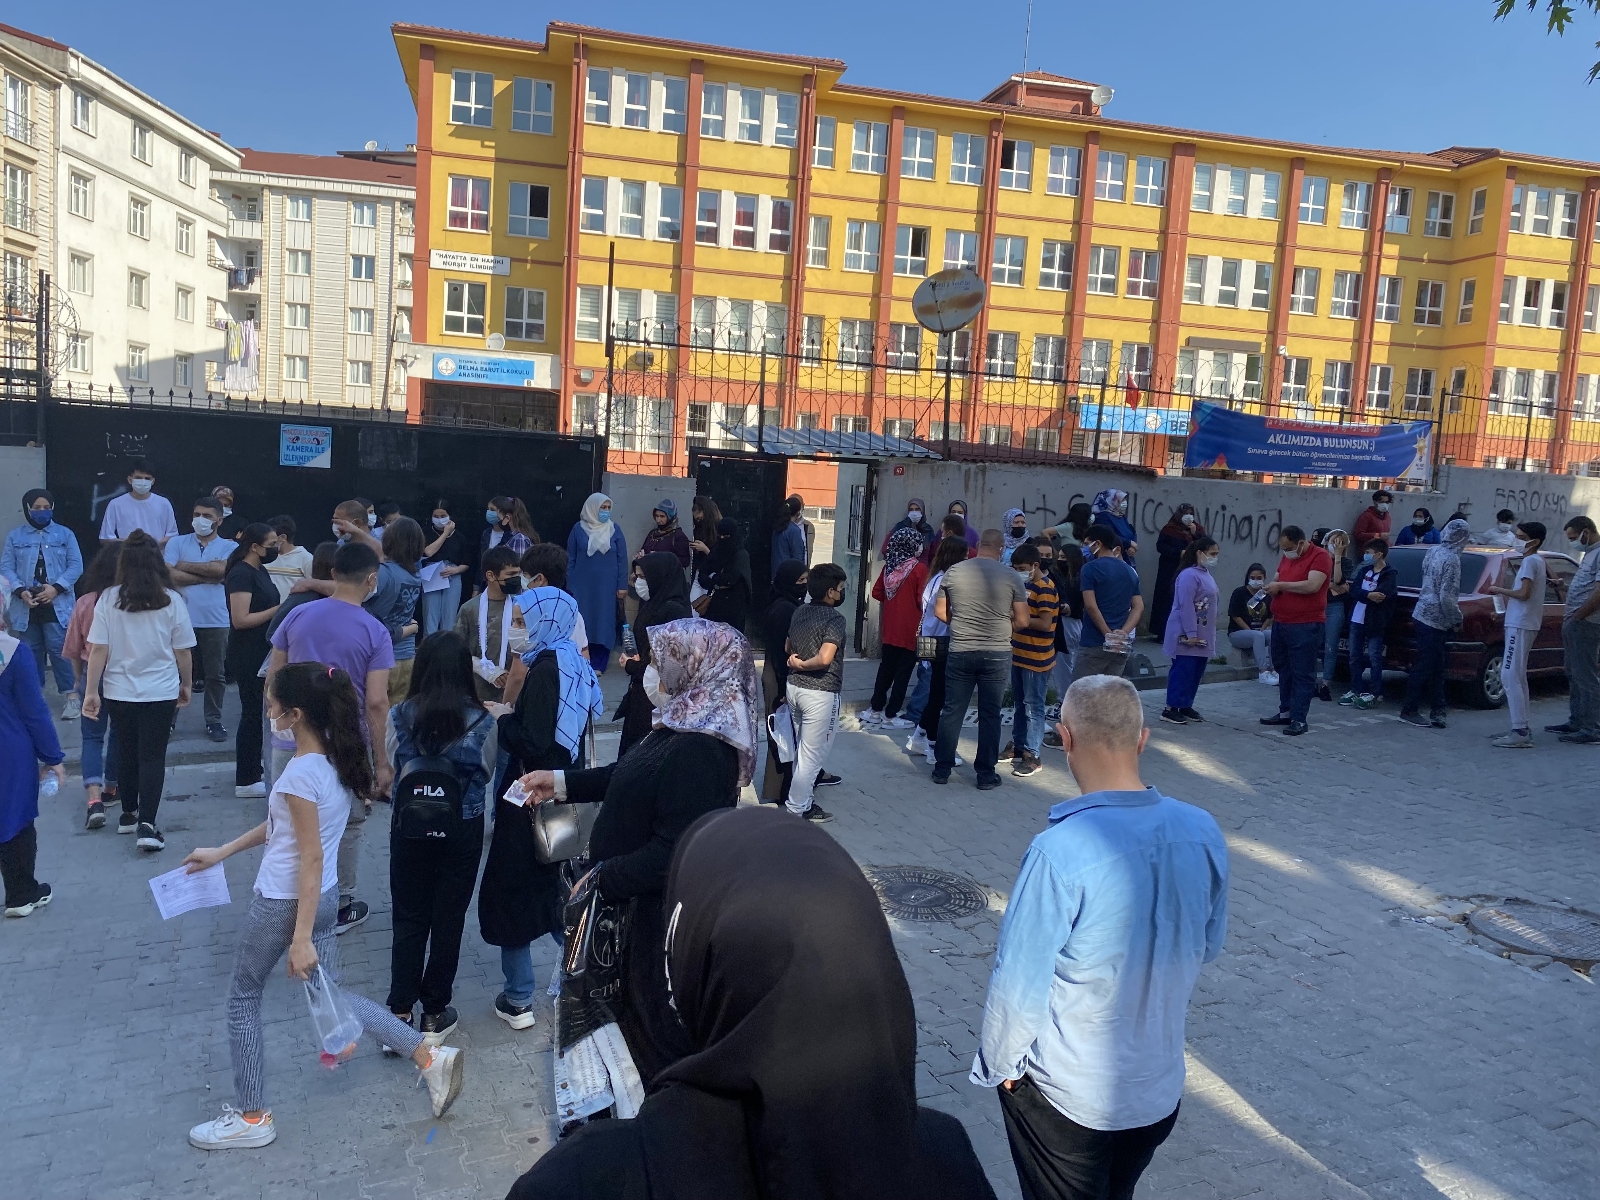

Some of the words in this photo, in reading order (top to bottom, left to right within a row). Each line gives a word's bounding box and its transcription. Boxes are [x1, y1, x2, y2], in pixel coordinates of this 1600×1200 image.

[1267, 434, 1322, 447] AKLIMIZDA
[1323, 438, 1369, 450] BULUNSUN
[286, 445, 314, 453] KAMERA
[314, 445, 325, 453] İLE
[1310, 451, 1350, 460] öğrencilerimize
[1510, 635, 1516, 644] TO
[414, 785, 445, 796] FILA
